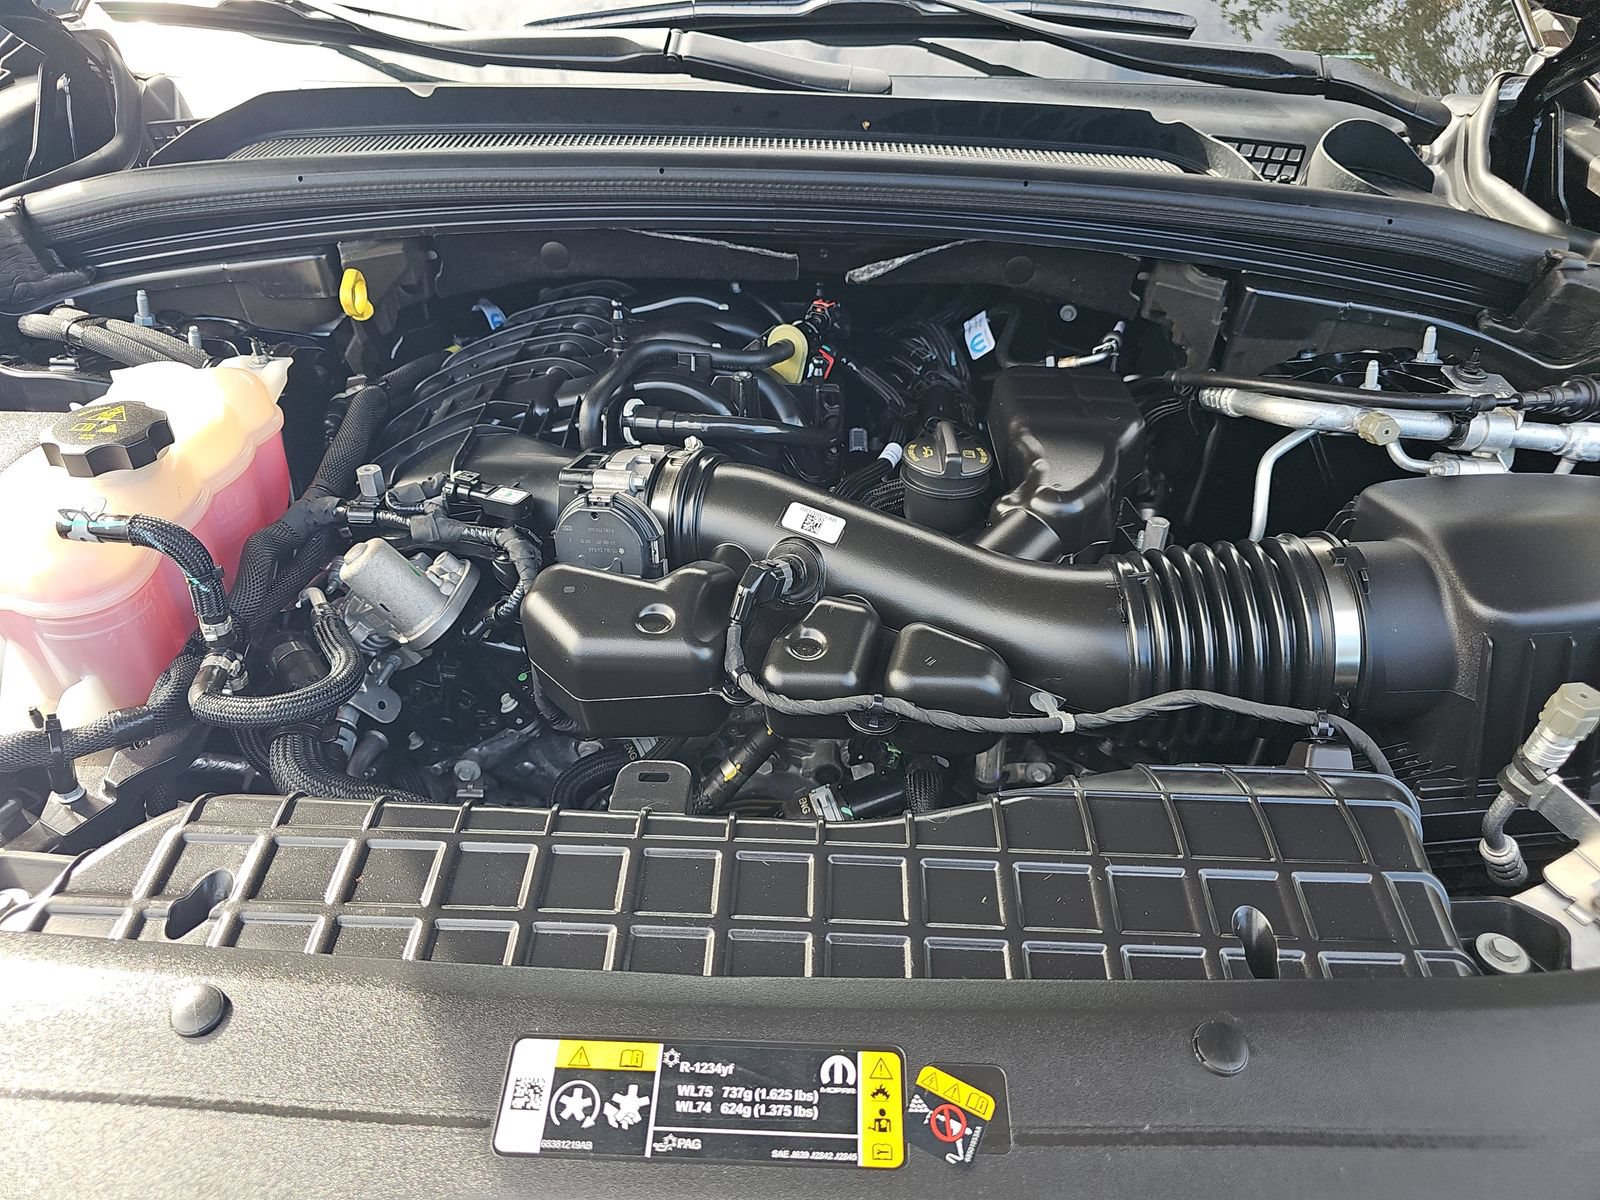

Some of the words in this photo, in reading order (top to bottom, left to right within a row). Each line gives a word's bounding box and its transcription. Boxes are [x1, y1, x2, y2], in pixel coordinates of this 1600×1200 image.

[798, 796, 811, 815] ENG
[679, 1062, 735, 1077] R-1234yf
[676, 1084, 713, 1098] WL75
[721, 1086, 753, 1102] 737g
[754, 1088, 793, 1103] (1.625
[794, 1090, 819, 1104] lbs)
[675, 1100, 712, 1114] WL74
[720, 1102, 752, 1117] 624g
[753, 1103, 793, 1118] (1.375
[793, 1105, 819, 1120] lbs)
[676, 1138, 702, 1149] PAG
[771, 1149, 790, 1158] SAE
